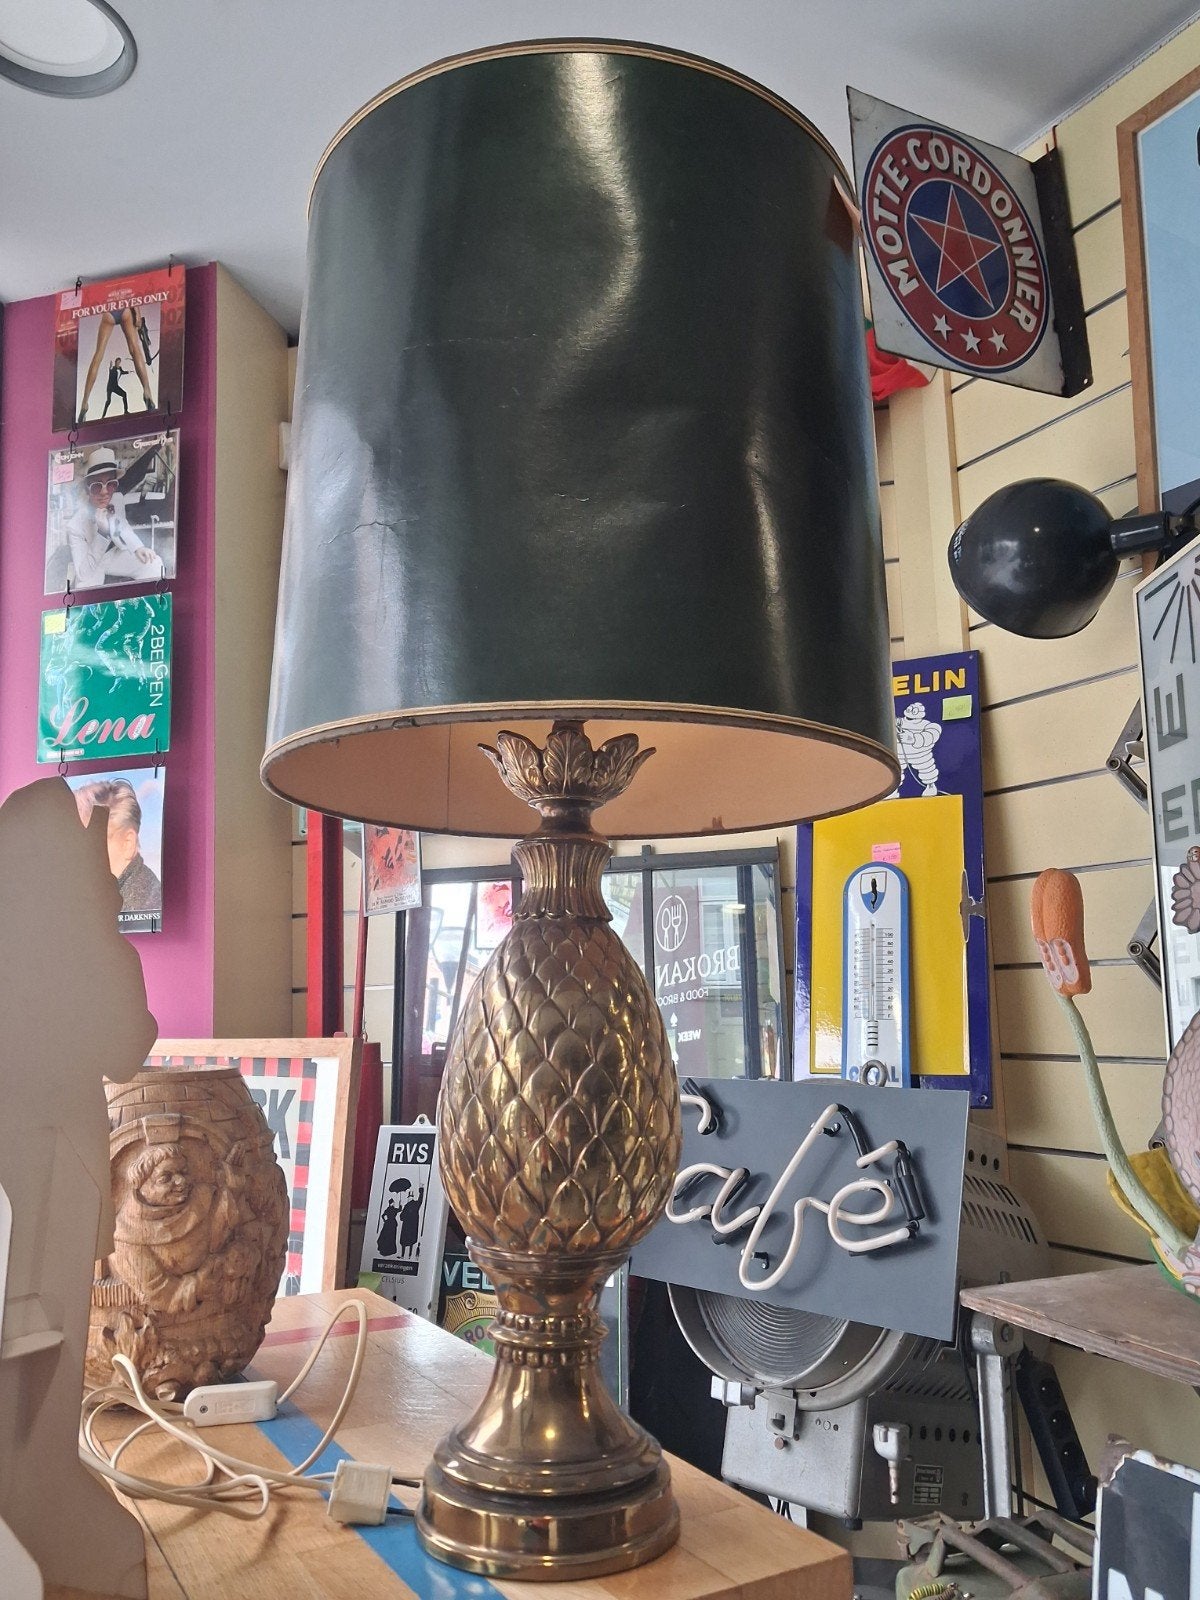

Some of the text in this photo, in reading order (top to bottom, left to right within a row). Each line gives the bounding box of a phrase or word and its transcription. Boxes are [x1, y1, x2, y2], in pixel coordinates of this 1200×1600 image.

[72, 308, 91, 319] FOR
[91, 301, 117, 315] YOUR
[118, 296, 143, 310] EYES
[143, 290, 170, 304] ONLY
[43, 696, 156, 748] Lena
[124, 912, 161, 922] DARKNESS
[391, 1142, 429, 1164] RVS
